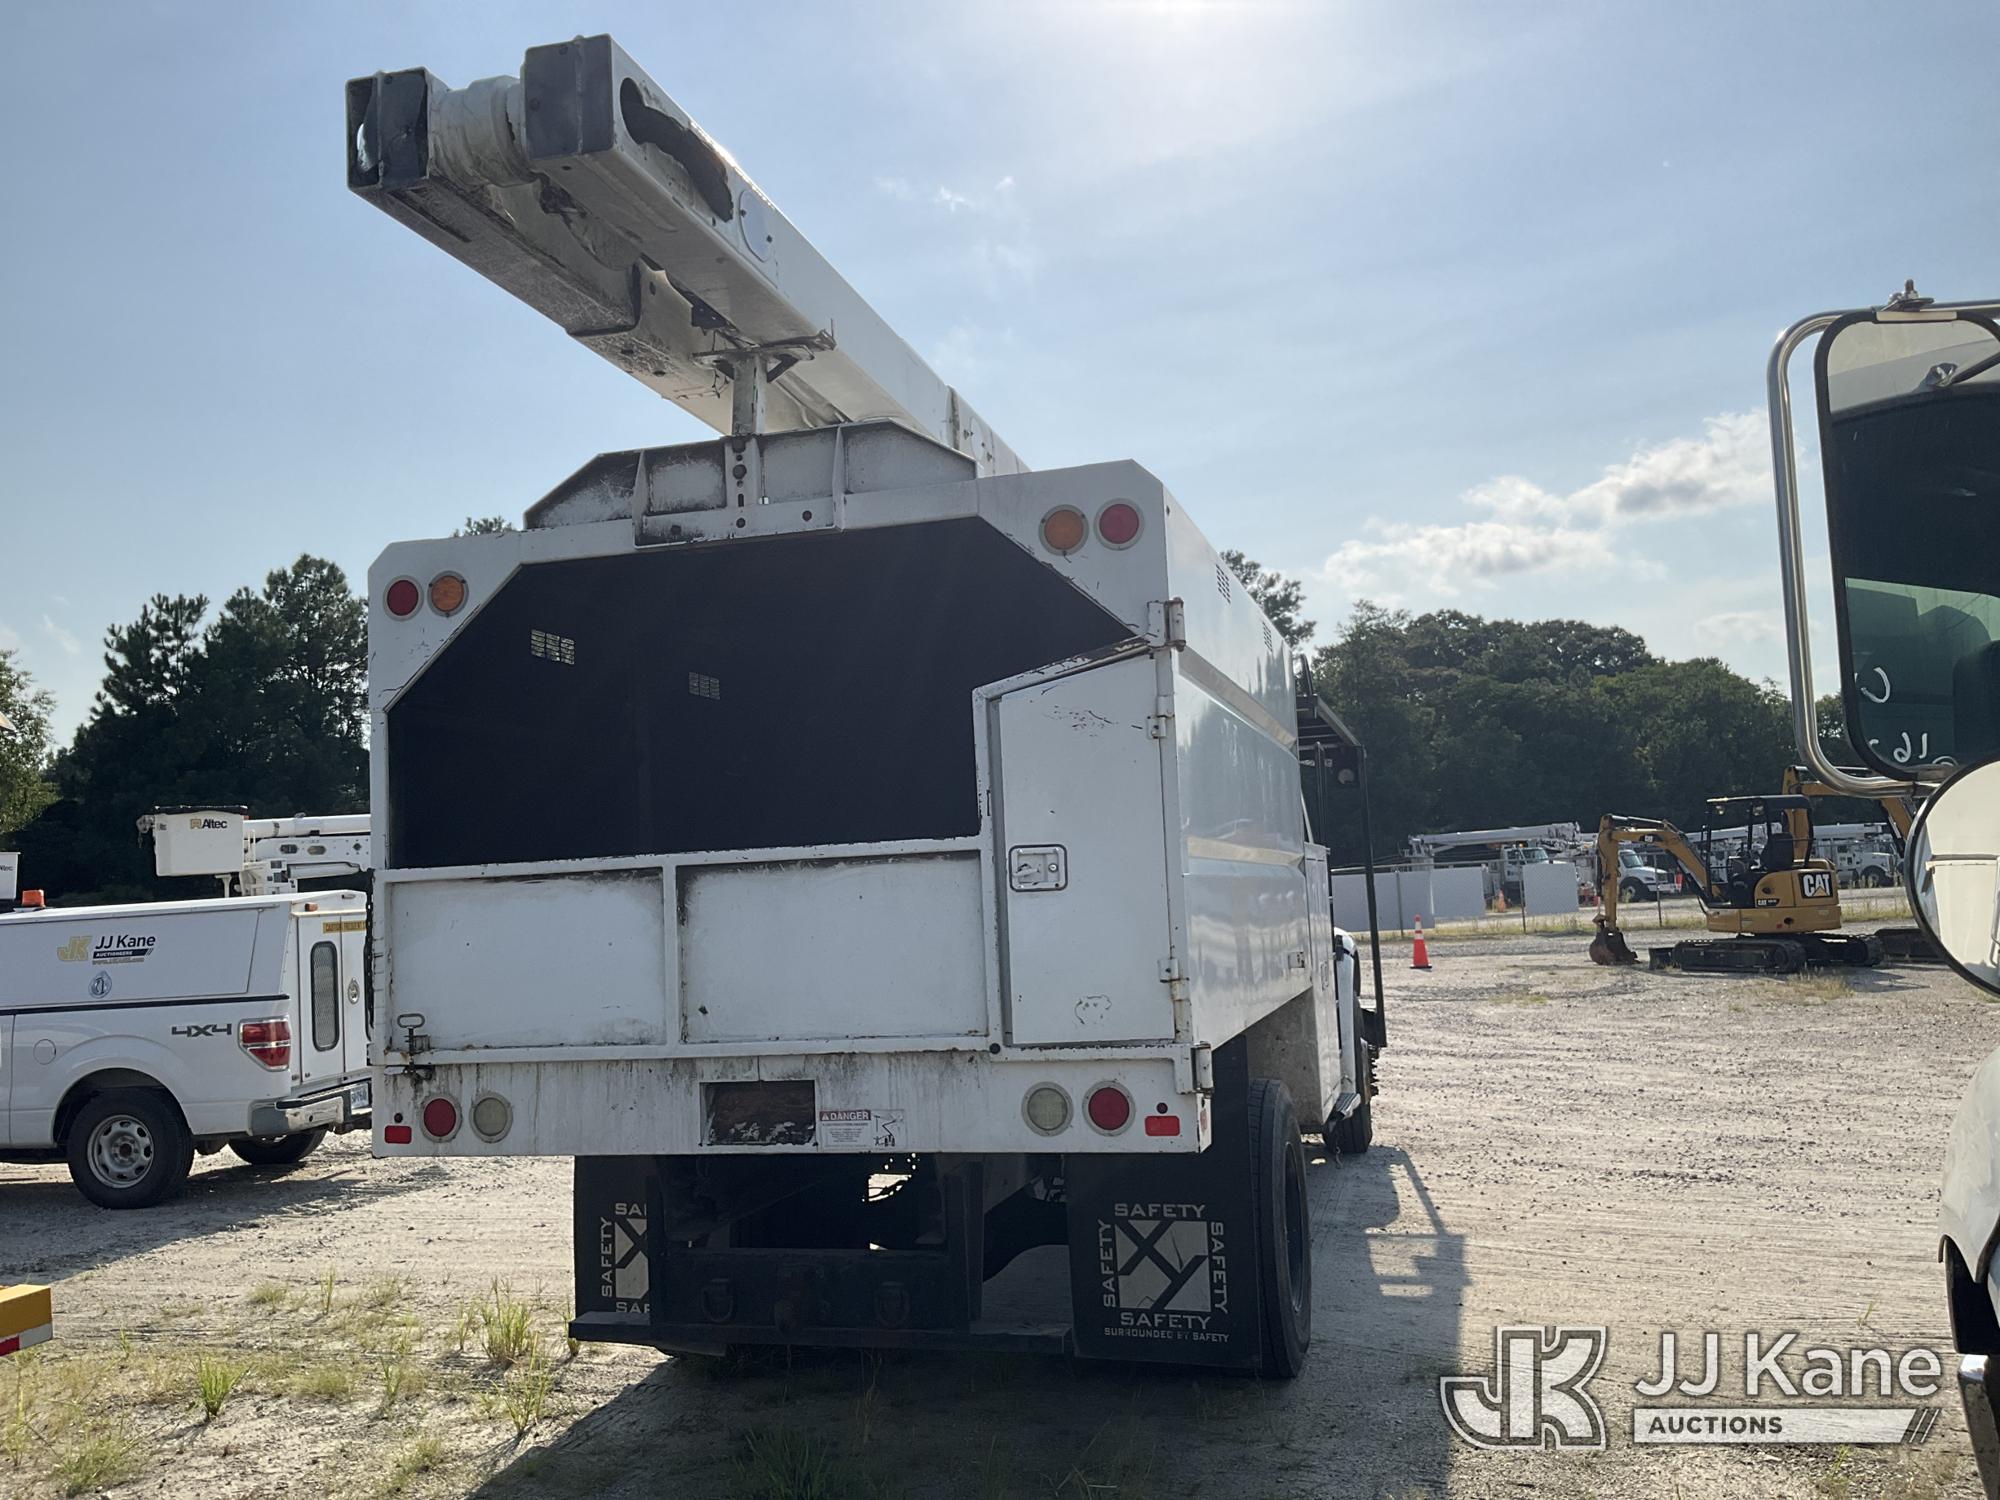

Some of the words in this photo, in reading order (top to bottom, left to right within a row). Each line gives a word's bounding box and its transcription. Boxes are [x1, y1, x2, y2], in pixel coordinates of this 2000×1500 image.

[202, 819, 228, 829] Altec
[1803, 874, 1831, 897] CAT
[95, 936, 114, 949] JJ
[116, 934, 156, 948] Kane
[830, 1111, 869, 1121] DANGER
[615, 1202, 647, 1215] SA
[1114, 1203, 1206, 1218] SAFETY
[600, 1216, 613, 1298] SAFETY
[1097, 1219, 1117, 1308] SAFETY
[1210, 1221, 1229, 1314] SAFETY
[1120, 1311, 1212, 1330] SAFETY
[1192, 1331, 1230, 1343] SAFETY
